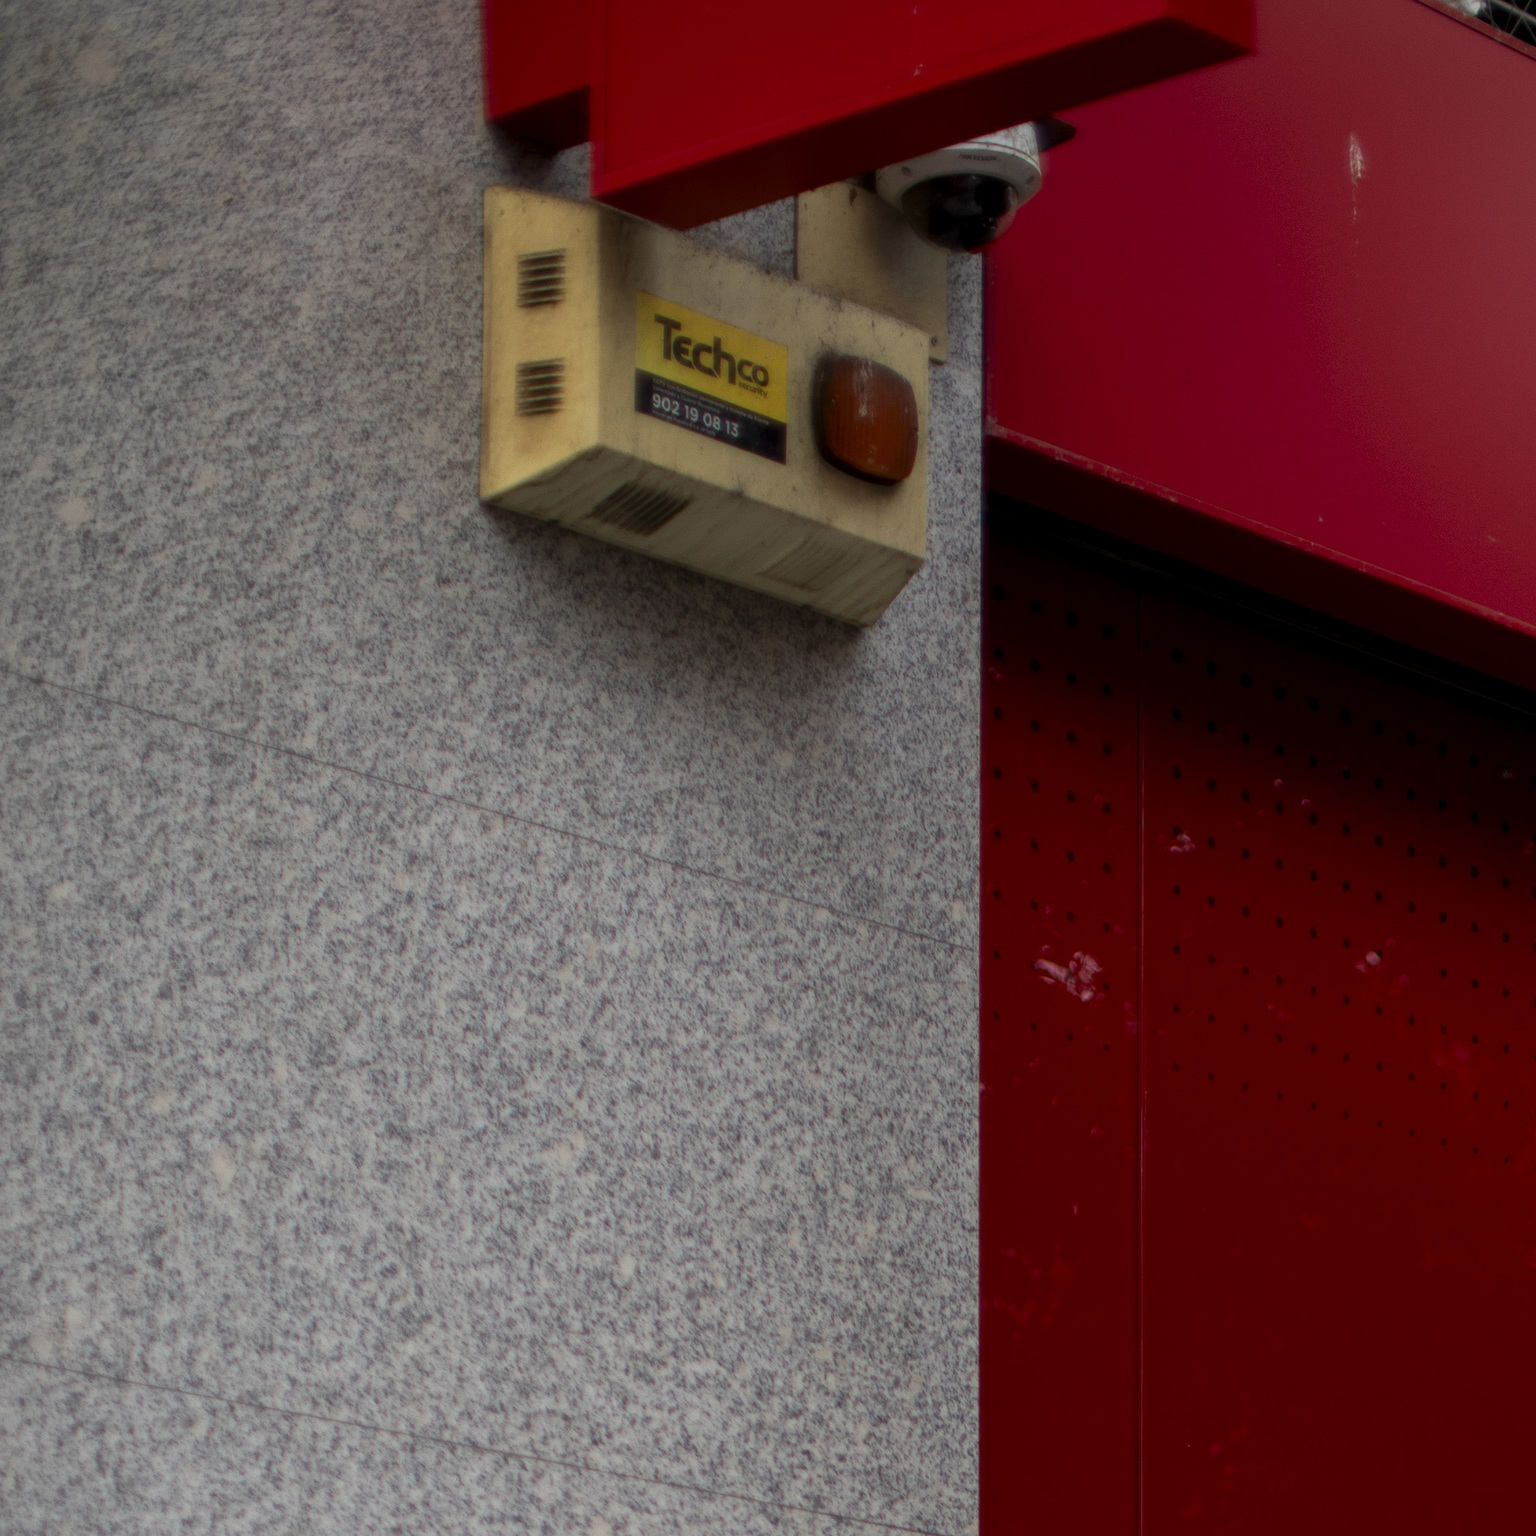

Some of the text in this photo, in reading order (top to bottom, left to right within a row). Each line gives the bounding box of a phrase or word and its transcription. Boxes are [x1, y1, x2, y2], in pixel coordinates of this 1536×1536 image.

[654, 313, 769, 387] Techco
[738, 381, 768, 399] security
[651, 392, 680, 416] 902
[684, 404, 699, 423] 19
[702, 412, 721, 431] 08
[725, 419, 740, 438] 13
